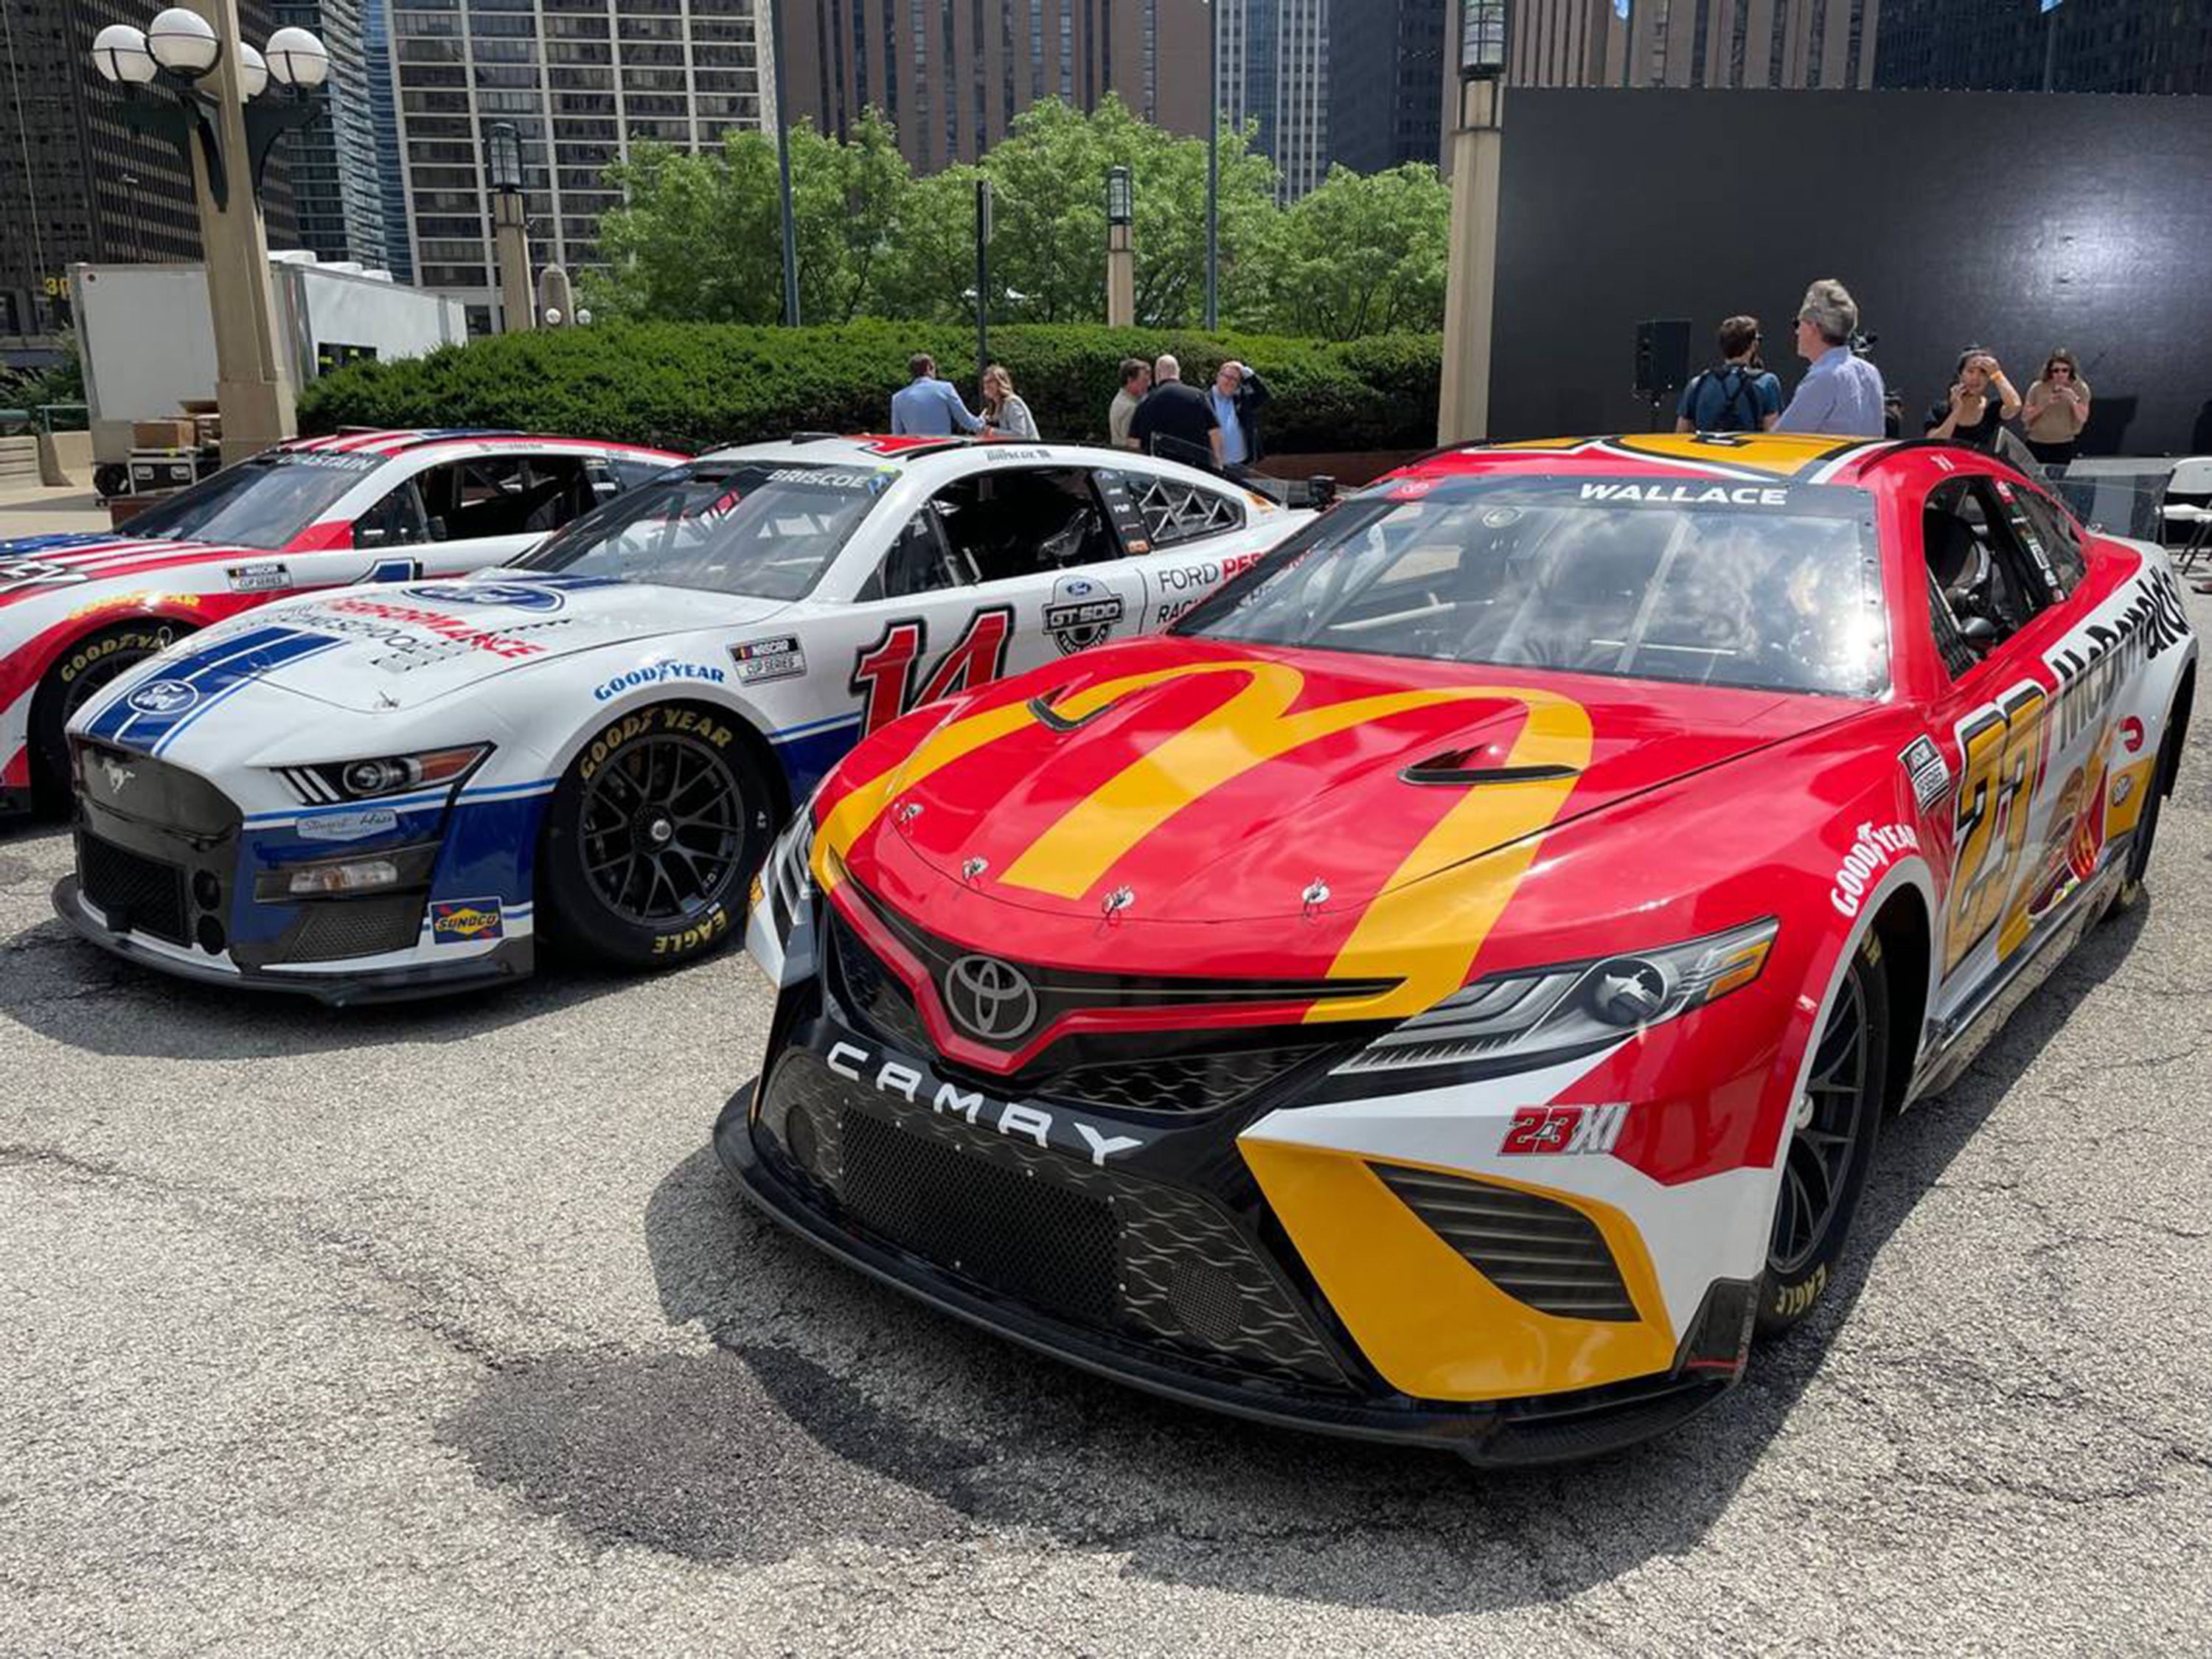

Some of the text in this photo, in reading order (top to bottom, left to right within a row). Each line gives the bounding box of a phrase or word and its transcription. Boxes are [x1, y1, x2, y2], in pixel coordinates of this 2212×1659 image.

[765, 468, 869, 488] BRISCOE
[1580, 483, 1789, 505] WALLACE
[1158, 563, 1219, 592] FORD
[594, 659, 725, 700] GOODYEAR
[849, 601, 1009, 740] 14
[580, 706, 732, 778] GOODYEAR
[1830, 821, 1920, 917] GOODYEAR
[434, 912, 500, 931] SUNOCO
[652, 908, 728, 954] EAGLE
[826, 1040, 1144, 1167] CAMRY
[1497, 1102, 1632, 1156] 23XI
[1774, 1261, 1826, 1316] EAGLE
